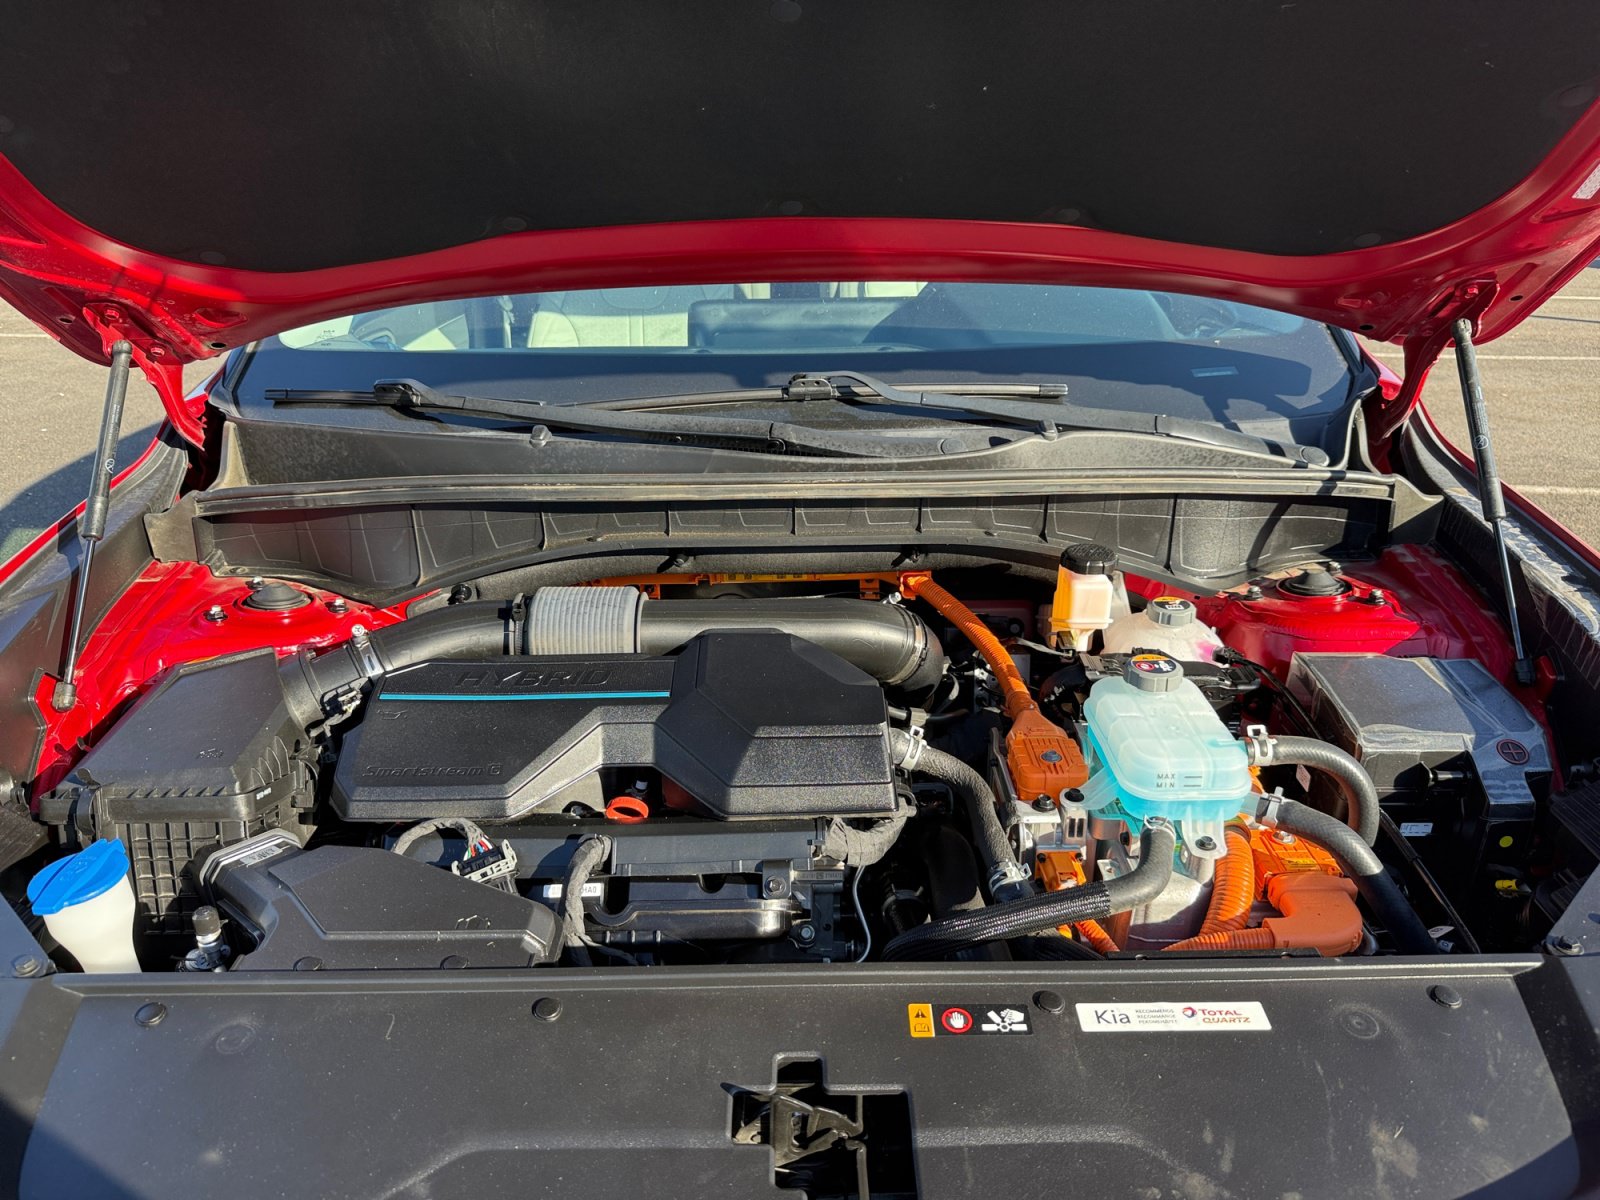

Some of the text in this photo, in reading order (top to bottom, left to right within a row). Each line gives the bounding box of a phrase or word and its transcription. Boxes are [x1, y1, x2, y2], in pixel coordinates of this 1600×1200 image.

[455, 669, 612, 688] HYBRID
[1094, 1009, 1132, 1025] Kia
[1199, 1008, 1243, 1016] TOTAL
